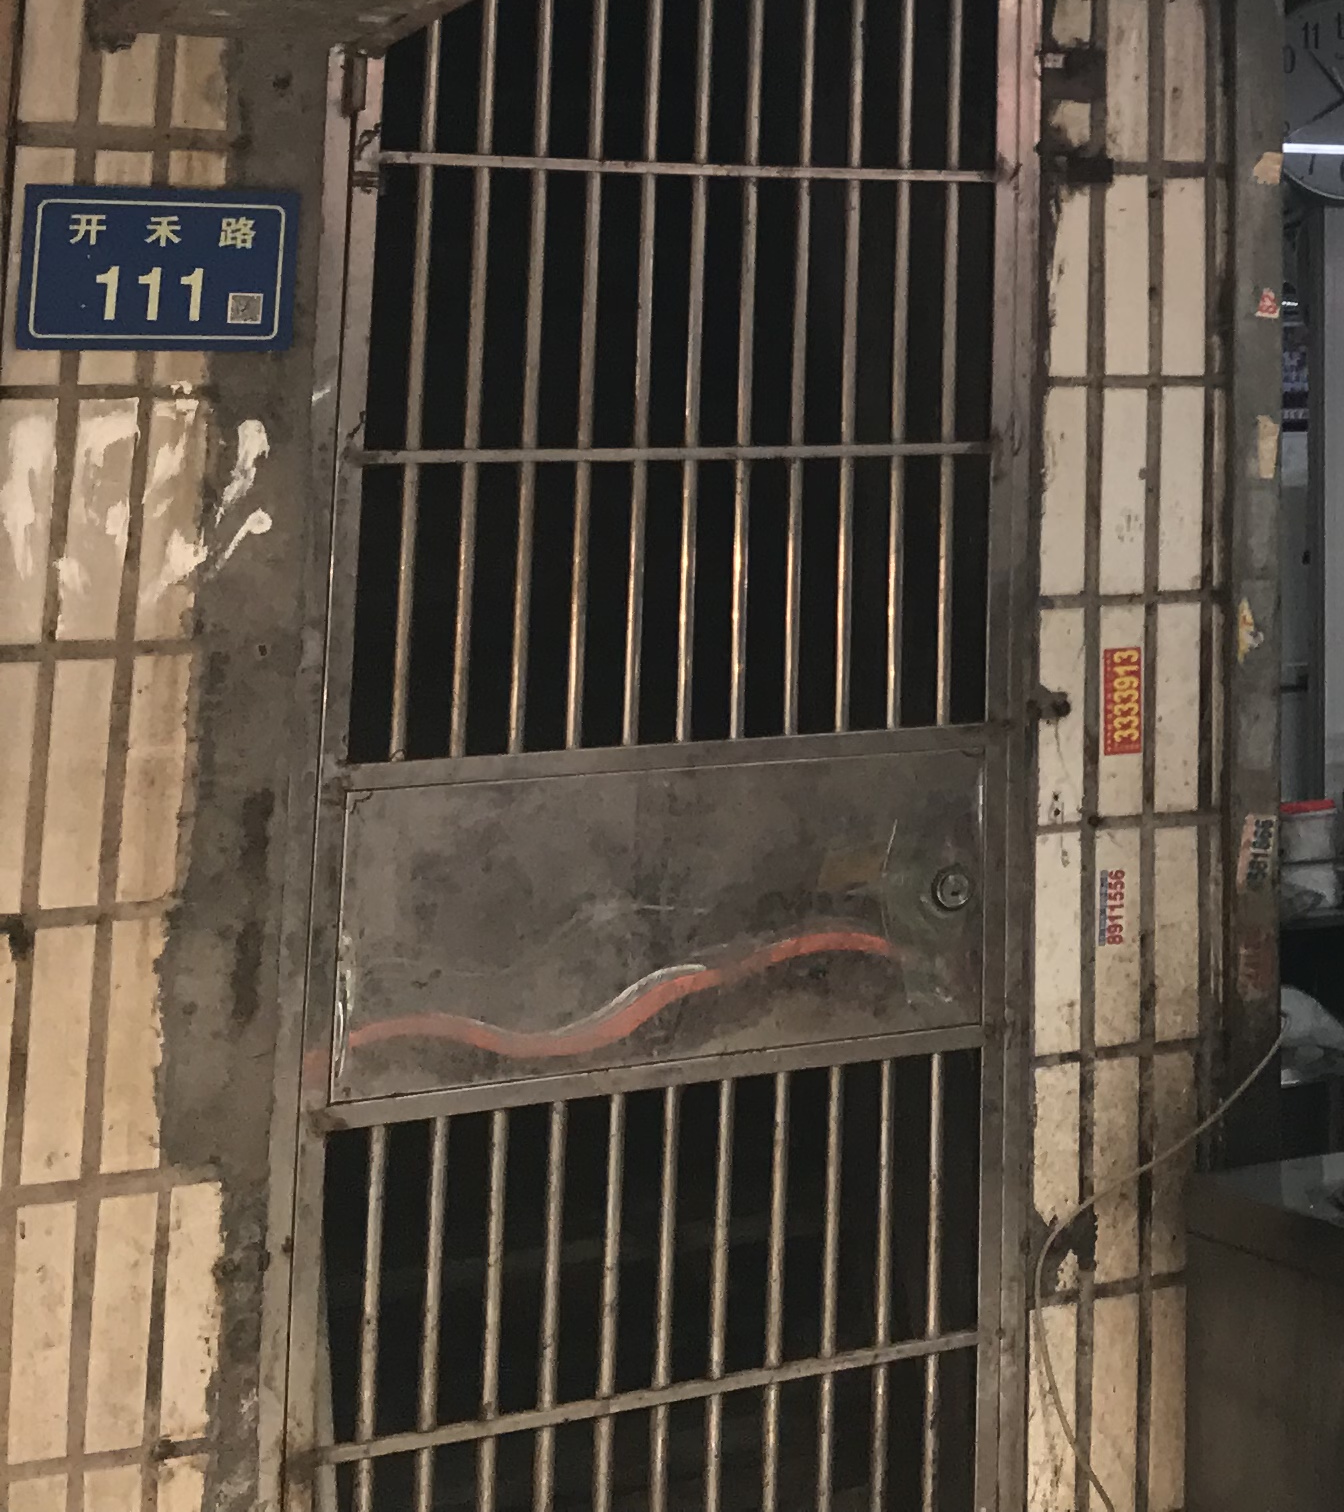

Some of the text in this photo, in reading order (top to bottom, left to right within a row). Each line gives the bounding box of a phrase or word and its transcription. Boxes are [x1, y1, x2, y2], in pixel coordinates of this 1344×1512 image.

[1282, 43, 1296, 74] 0
[1302, 20, 1319, 50] 11
[68, 213, 257, 250] 开禾路
[95, 265, 205, 322] 111
[1113, 648, 1140, 743] 3333913
[1105, 868, 1127, 946] 8911556
